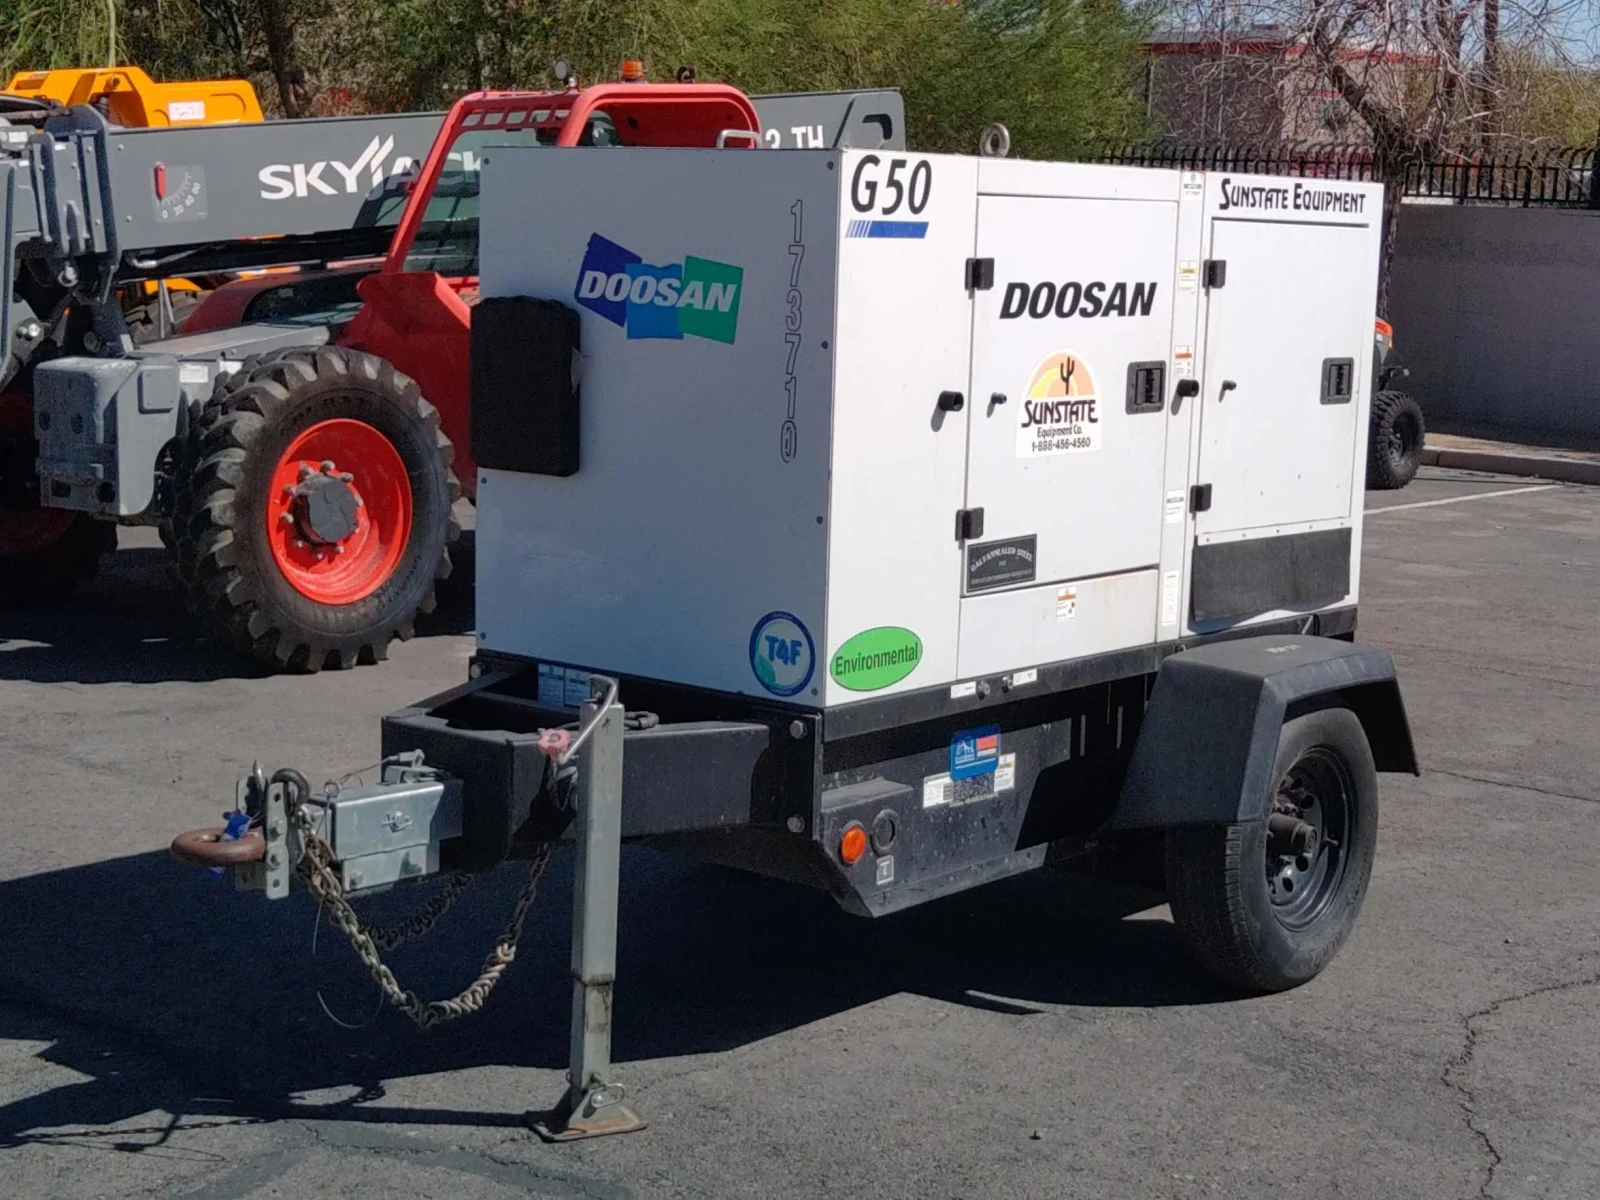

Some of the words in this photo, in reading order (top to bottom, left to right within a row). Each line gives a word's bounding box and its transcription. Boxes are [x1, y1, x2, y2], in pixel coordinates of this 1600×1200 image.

[850, 154, 932, 215] G50
[1219, 178, 1288, 210] SUNSTATE
[1293, 183, 1366, 213] EQUIPMENT
[578, 270, 737, 312] DOOSAN
[999, 281, 1157, 319] DOOSAN
[1021, 399, 1098, 428] SUNSTATE
[1037, 425, 1072, 439] Equipment
[765, 634, 803, 666] T4F
[835, 641, 918, 676] Environmental
